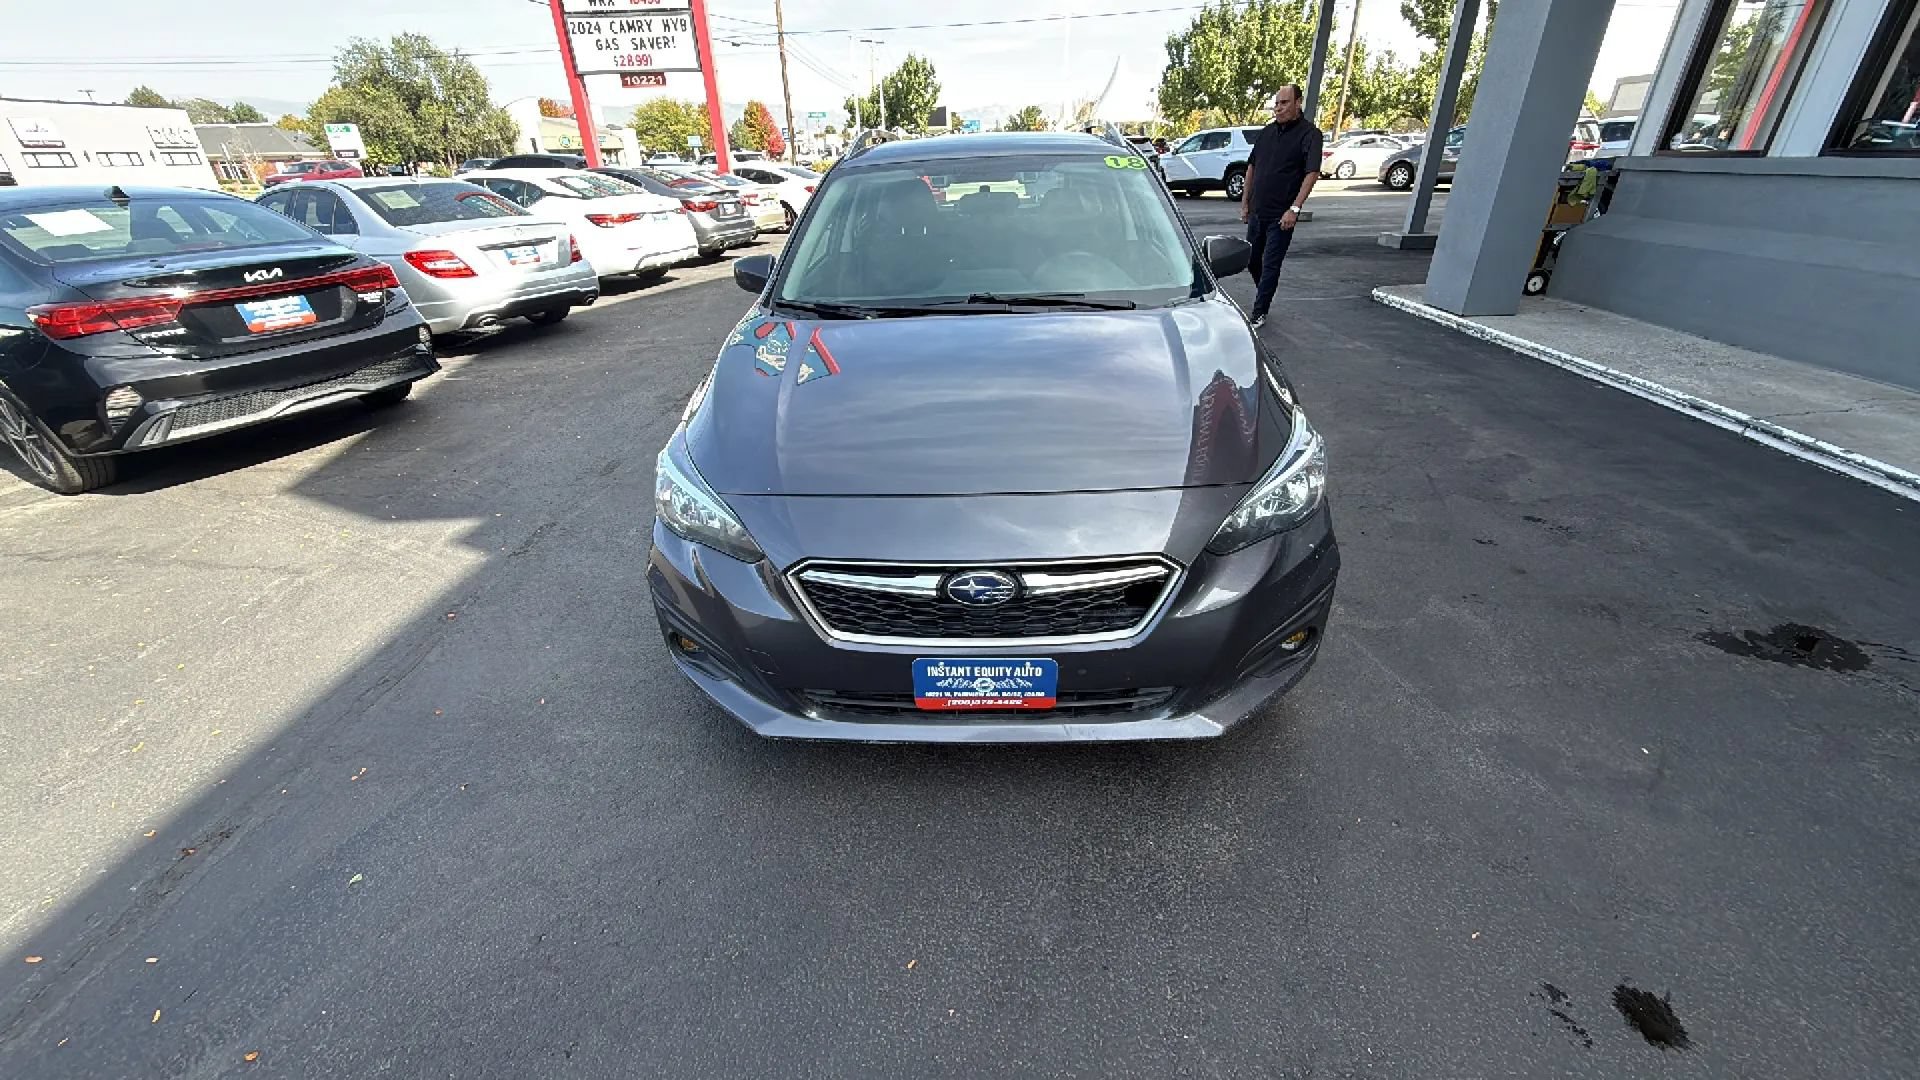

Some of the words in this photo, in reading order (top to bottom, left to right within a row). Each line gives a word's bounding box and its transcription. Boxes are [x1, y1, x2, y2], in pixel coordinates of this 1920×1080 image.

[569, 22, 602, 35] 2024
[609, 19, 653, 34] CAMRY
[662, 18, 688, 32] HYB
[595, 38, 620, 51] GAS
[630, 36, 677, 51] SAVER!
[624, 75, 664, 86] 10221
[1107, 156, 1146, 169] 18
[243, 267, 283, 283] KIA
[927, 665, 971, 677] INSTANT
[974, 666, 1013, 677] EQUITY
[1014, 665, 1043, 677] AUTO
